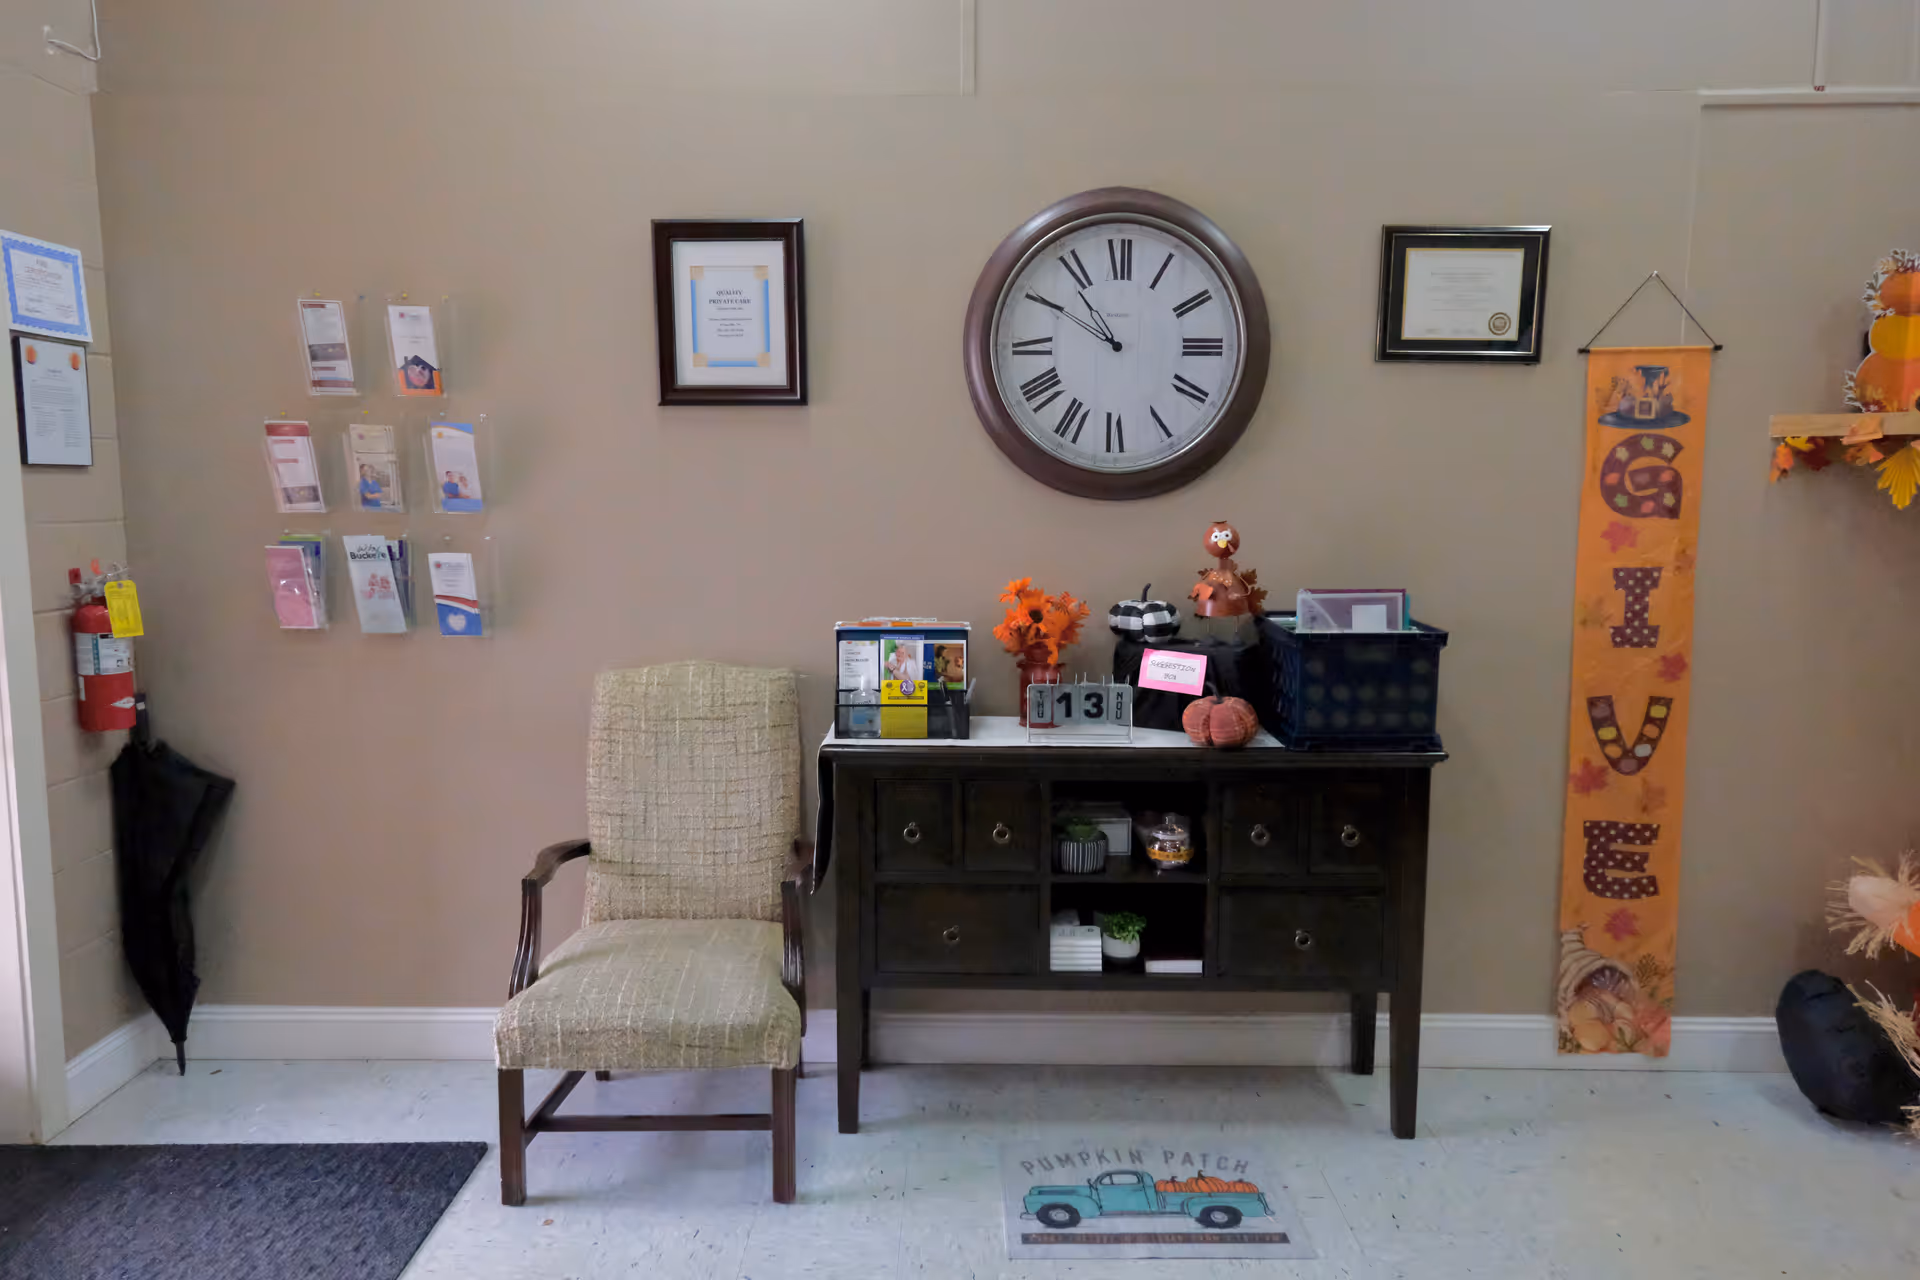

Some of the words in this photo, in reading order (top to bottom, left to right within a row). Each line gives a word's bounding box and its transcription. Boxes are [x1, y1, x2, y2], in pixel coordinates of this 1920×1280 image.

[1151, 659, 1196, 673] SUGGESTION
[1583, 433, 1685, 900] GIVE
[1020, 1147, 1144, 1175] PUMPKIN
[1163, 1150, 1249, 1174] PATCH
